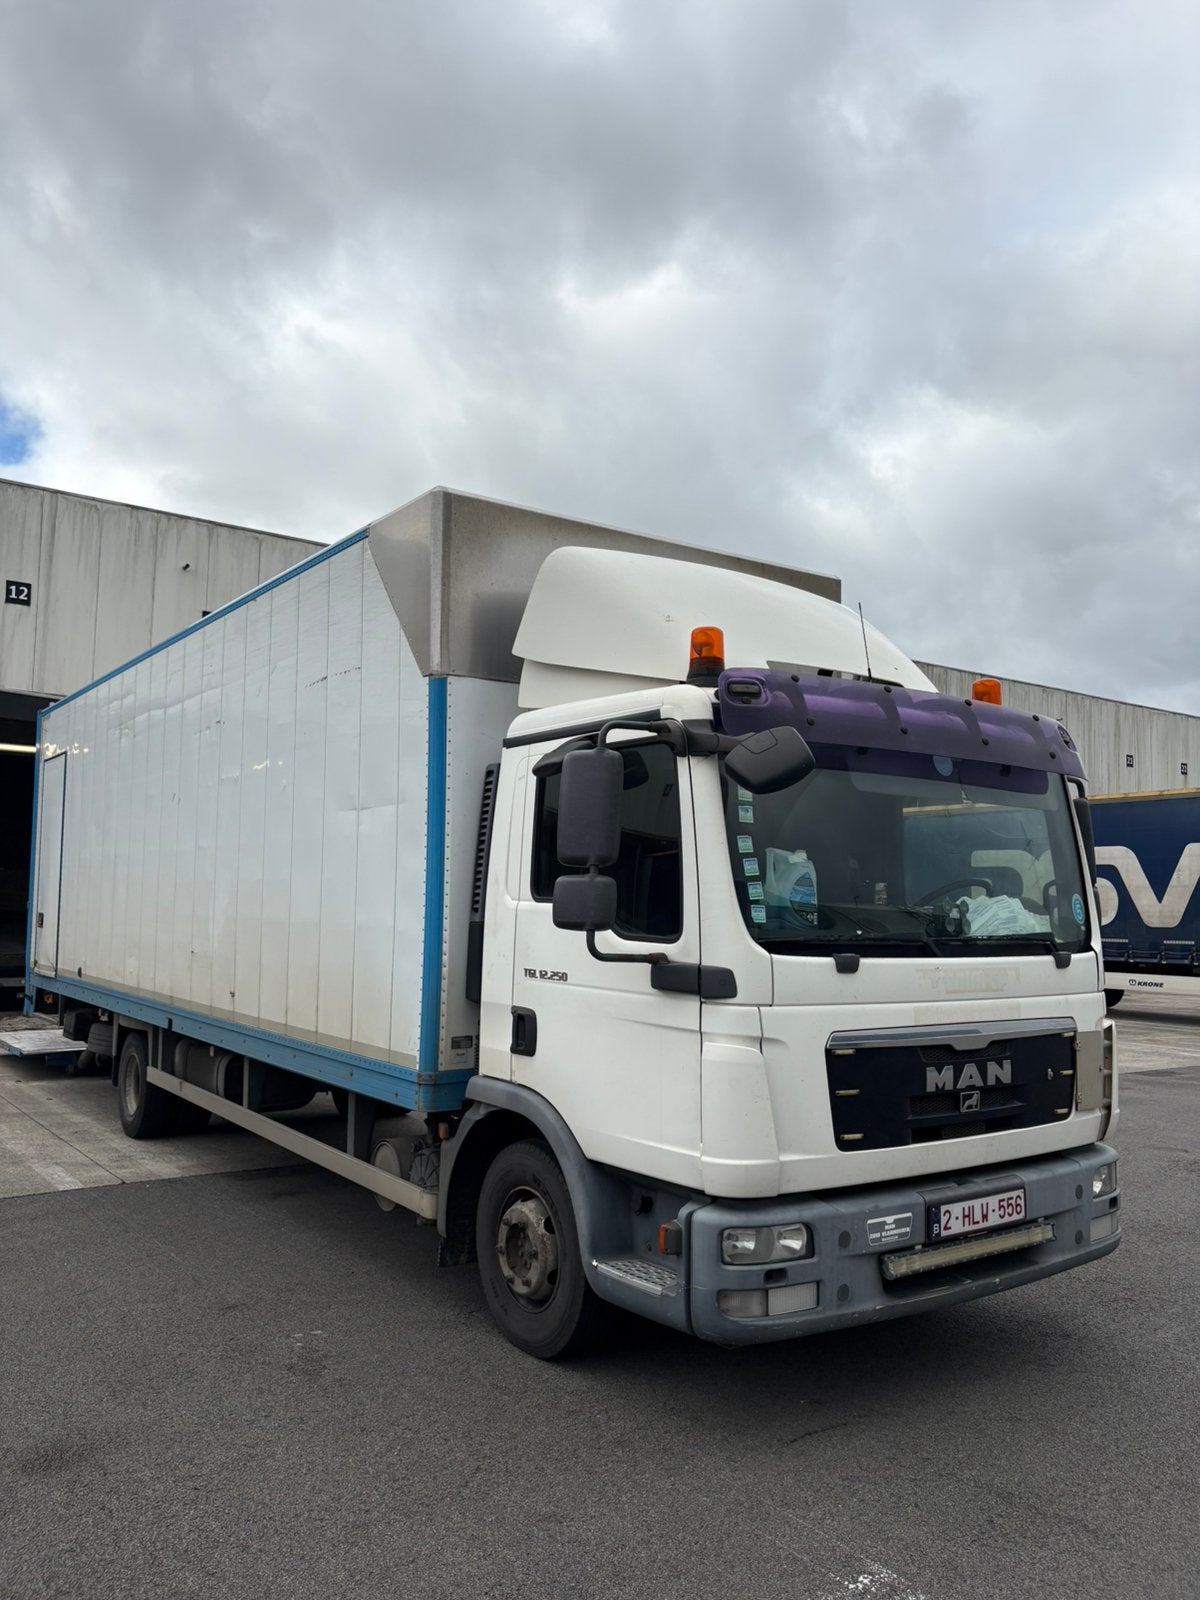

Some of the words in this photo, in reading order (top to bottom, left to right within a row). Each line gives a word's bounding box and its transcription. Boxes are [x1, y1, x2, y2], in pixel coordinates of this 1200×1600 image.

[9, 585, 29, 601] 12
[539, 969, 568, 982] 12.250
[926, 1059, 1012, 1092] MAN
[933, 1223, 940, 1234] B
